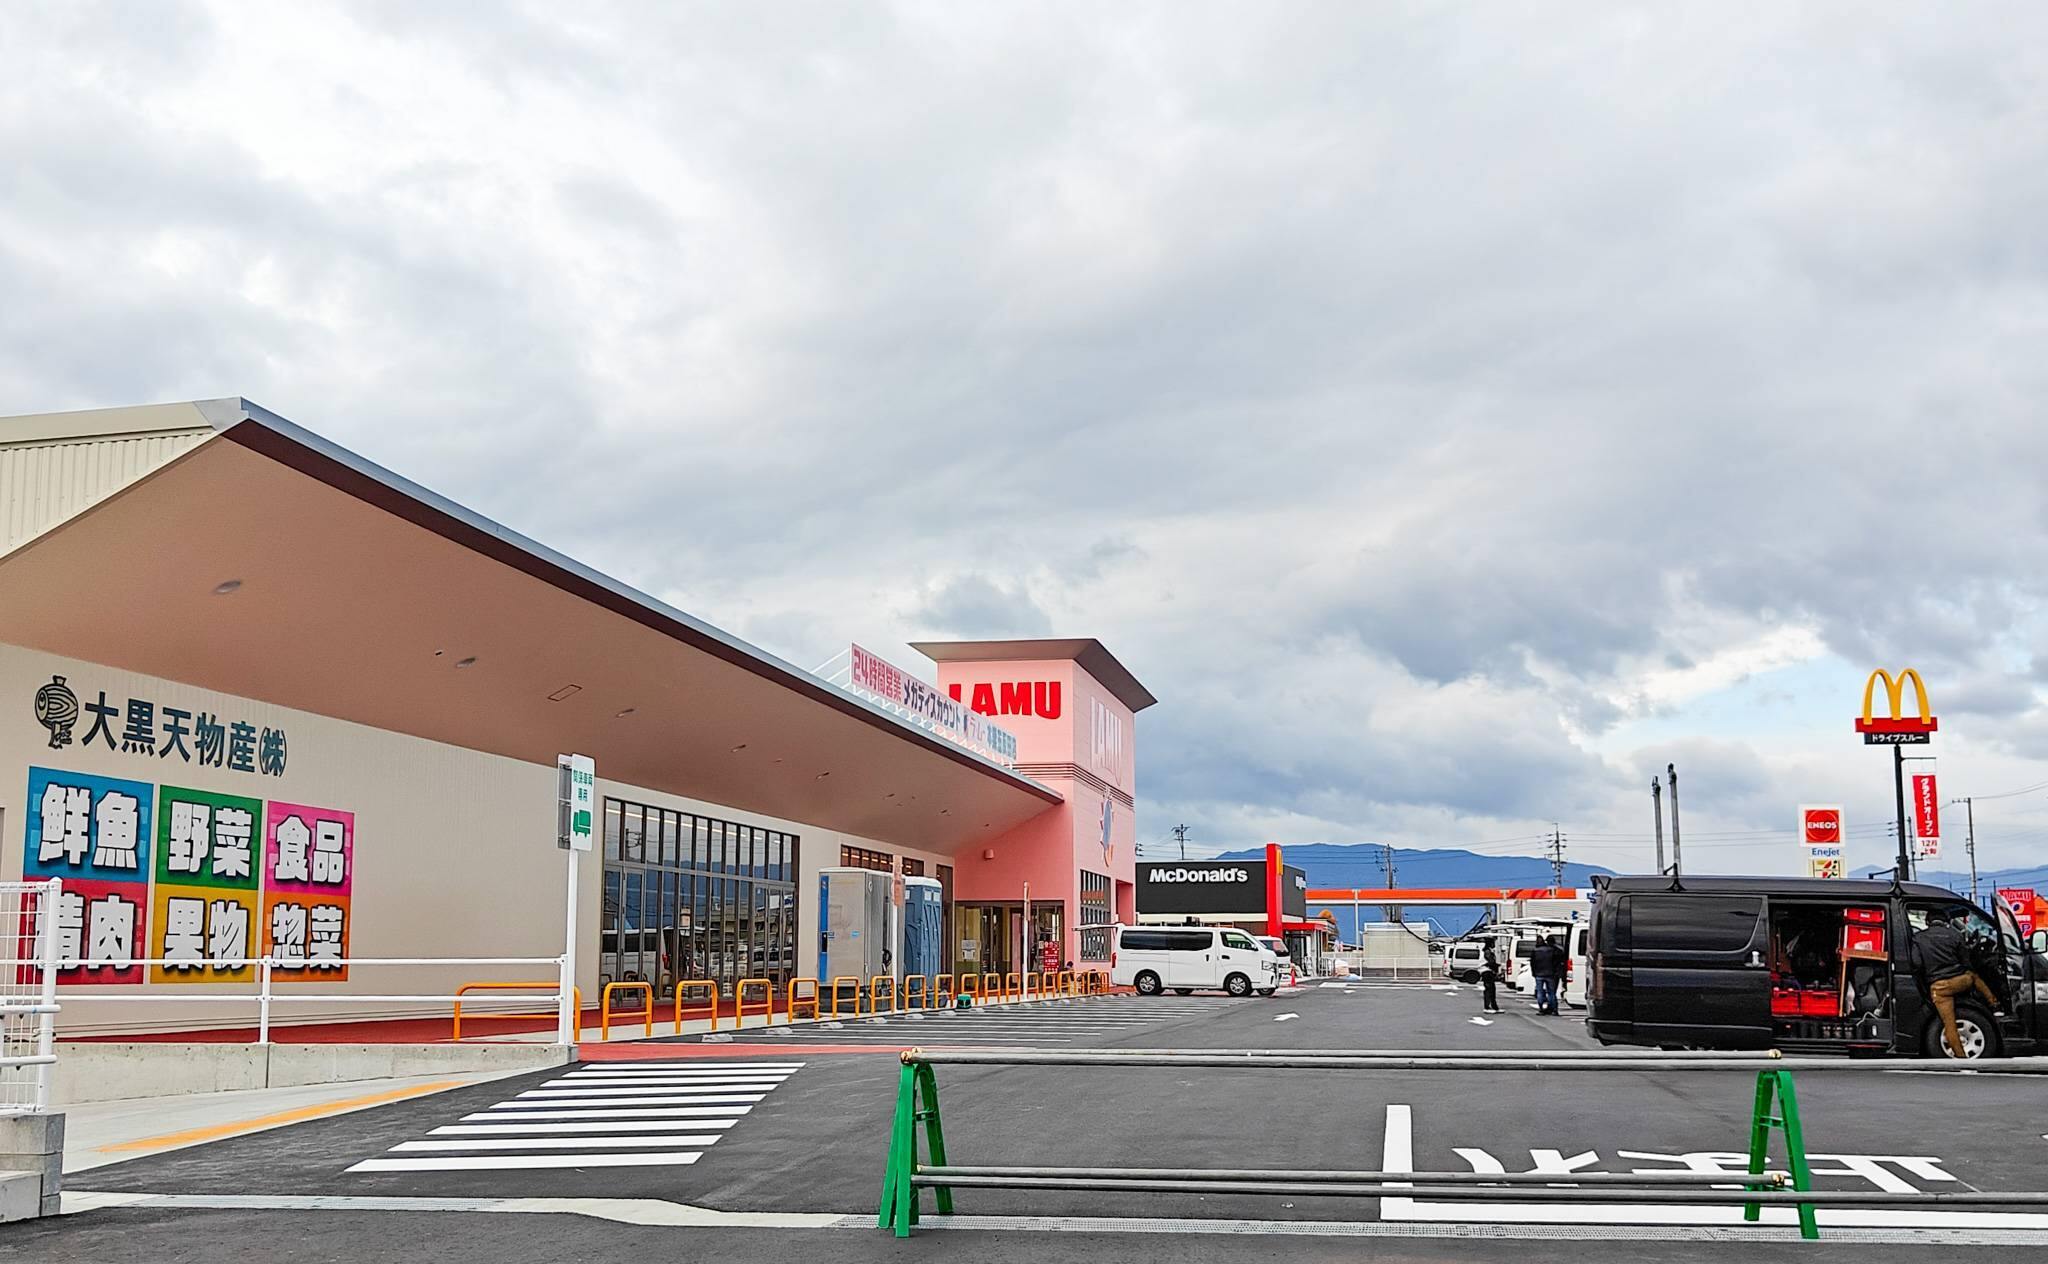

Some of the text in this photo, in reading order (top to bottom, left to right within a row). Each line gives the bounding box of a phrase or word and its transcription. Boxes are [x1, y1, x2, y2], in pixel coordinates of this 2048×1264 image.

[1872, 733, 1924, 743] ドライブスルー
[1921, 778, 1934, 835] グランドオープン
[38, 783, 347, 885] 鮮魚 野菜 食品
[1807, 821, 1837, 830] ENEOS
[1149, 868, 1249, 883] McDonald's
[163, 896, 249, 972] 果物
[271, 903, 345, 972] 惣菜
